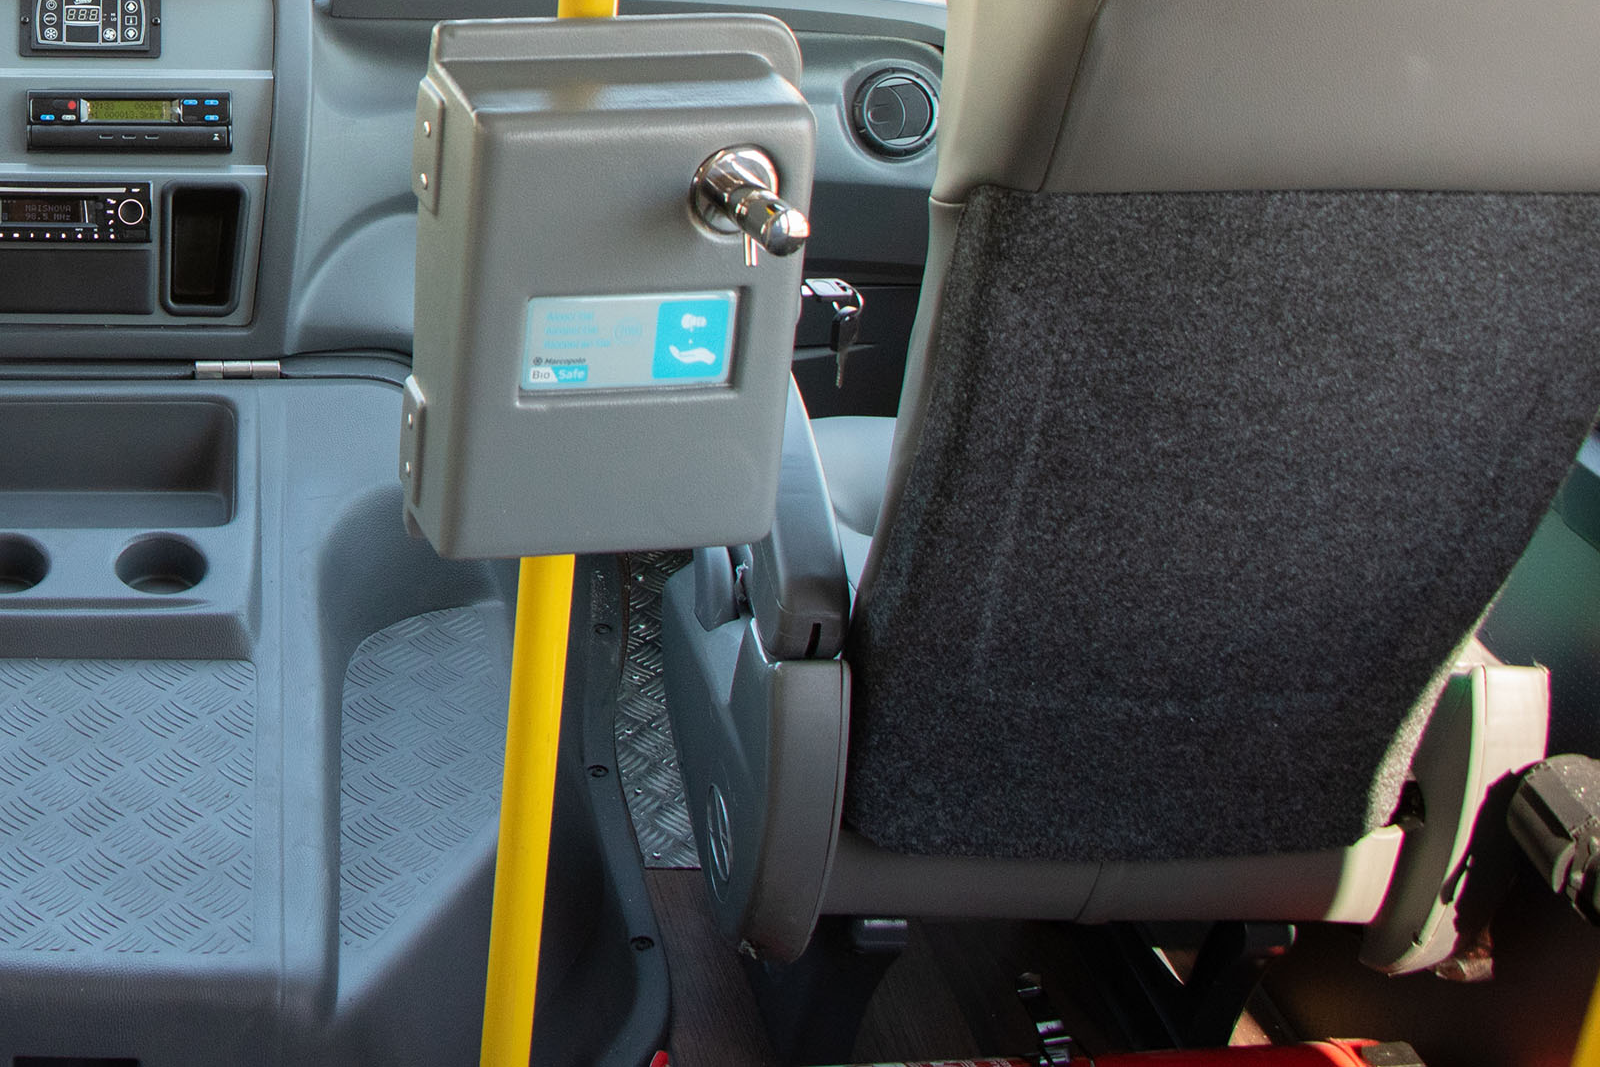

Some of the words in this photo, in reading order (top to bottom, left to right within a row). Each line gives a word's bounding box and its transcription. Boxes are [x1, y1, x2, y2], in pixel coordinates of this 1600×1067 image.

[25, 213, 49, 221] 98.5
[53, 213, 72, 221] MHz
[544, 357, 586, 365] Marcopolo
[532, 369, 550, 380] Bio
[558, 368, 585, 380] Safe
